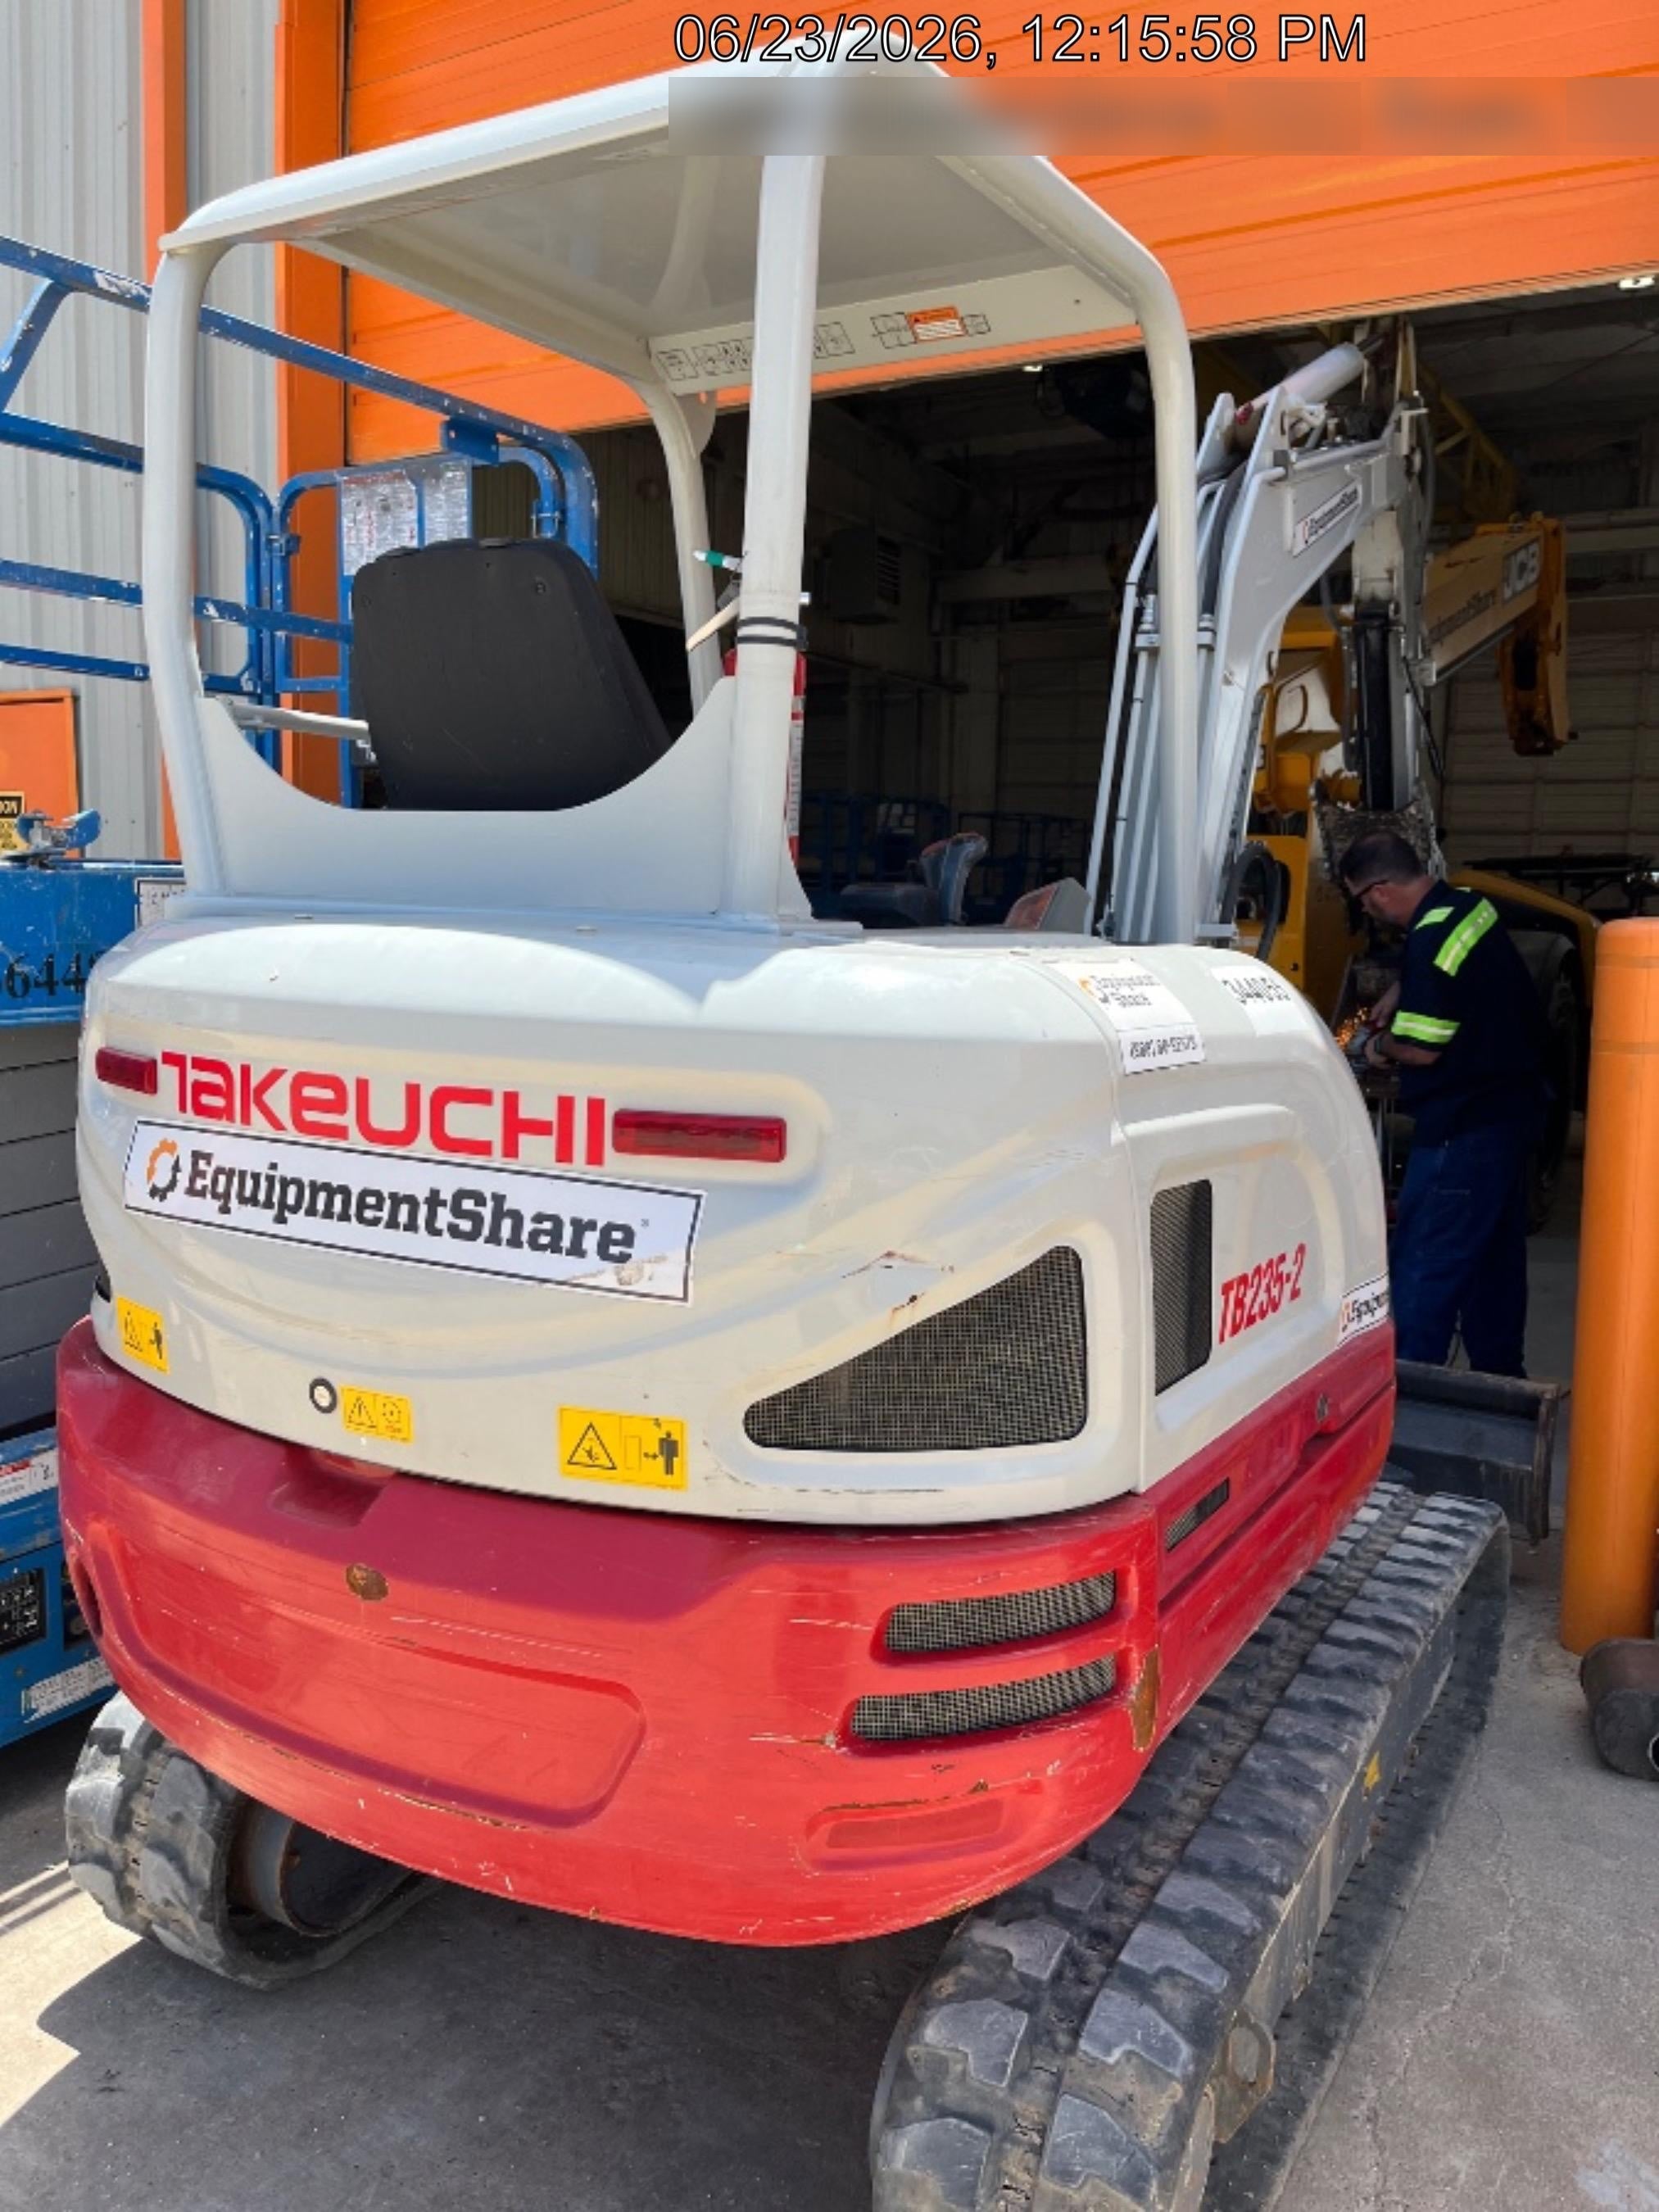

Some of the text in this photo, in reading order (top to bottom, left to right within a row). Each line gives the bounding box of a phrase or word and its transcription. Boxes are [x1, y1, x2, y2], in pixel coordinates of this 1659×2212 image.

[1504, 541, 1540, 601] JCB
[187, 1149, 636, 1264] EquipmentShare
[1219, 1243, 1307, 1344] TB235-2
